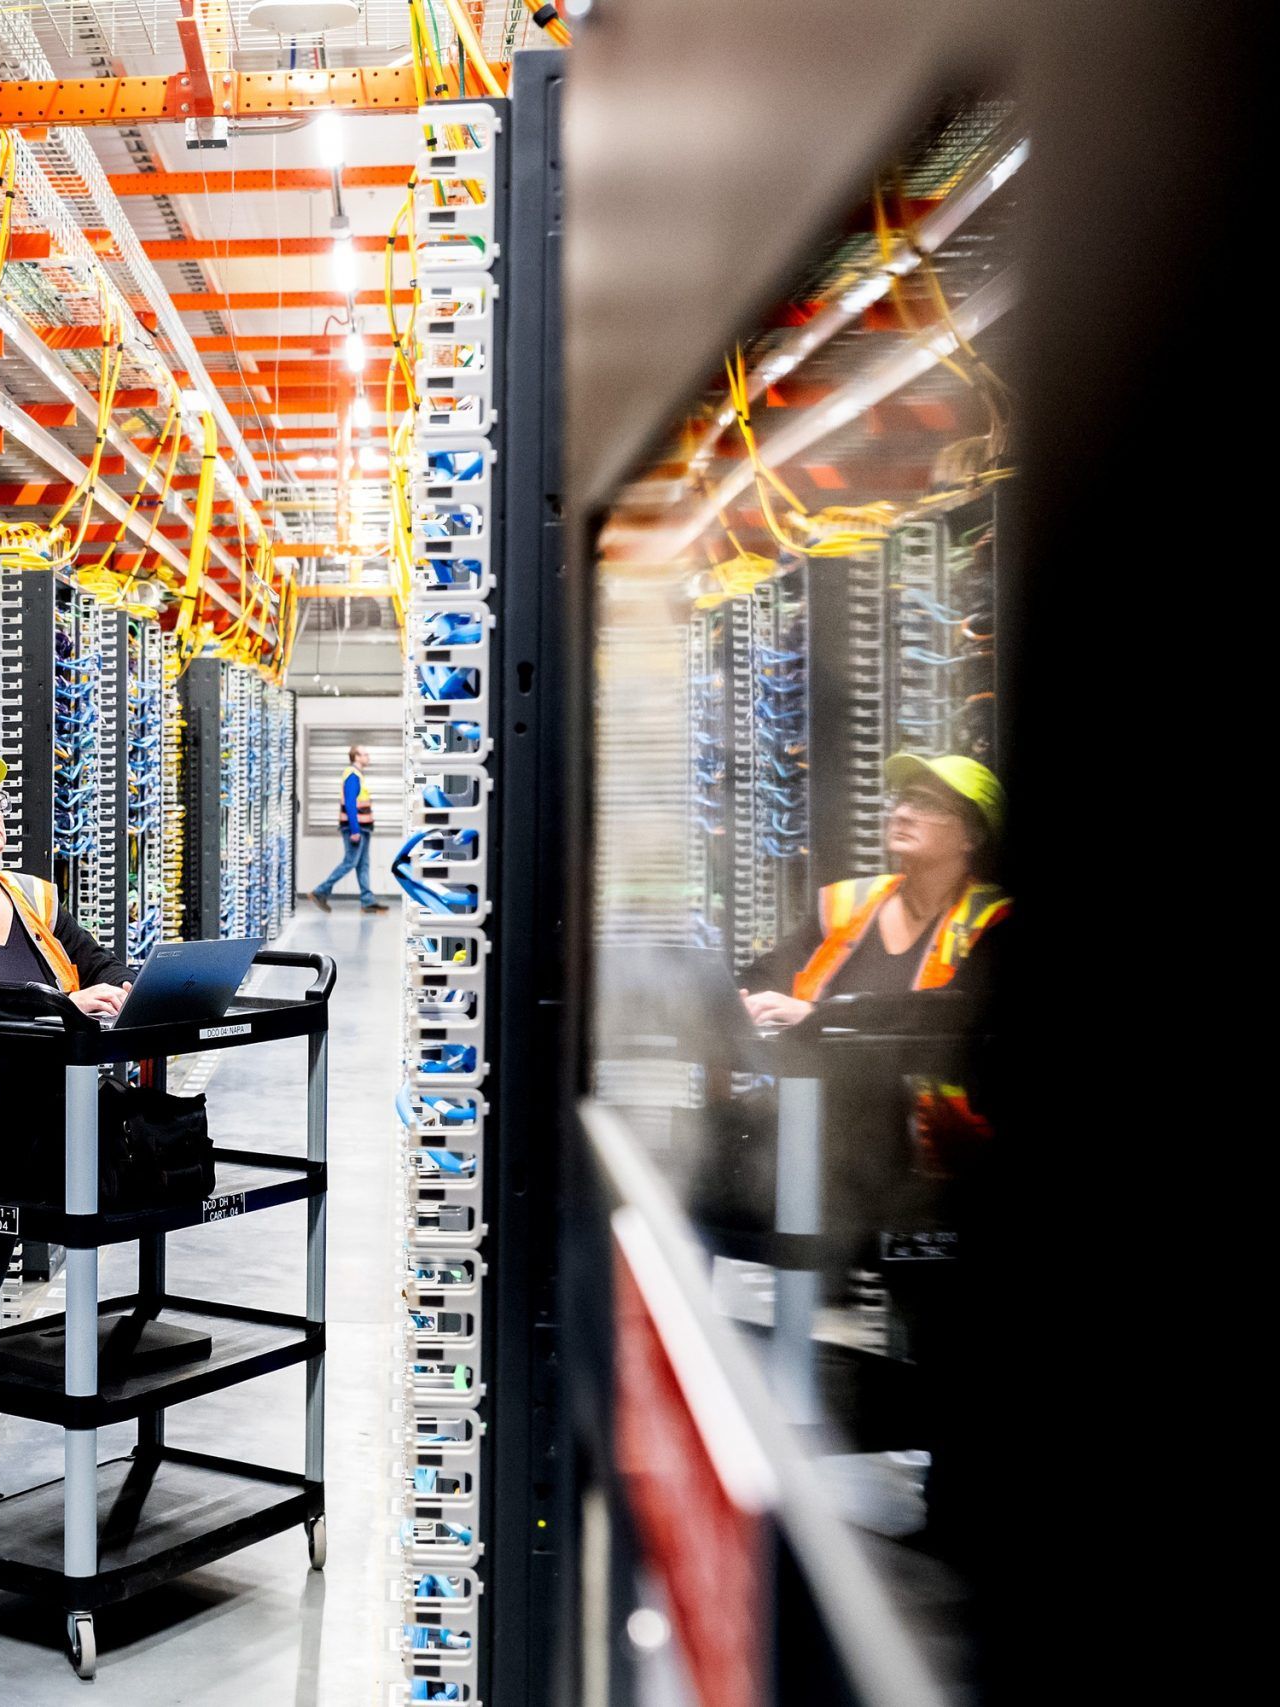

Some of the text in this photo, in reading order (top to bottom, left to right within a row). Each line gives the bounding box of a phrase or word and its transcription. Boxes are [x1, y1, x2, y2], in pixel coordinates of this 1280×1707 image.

[230, 1025, 245, 1034] NAPA
[202, 1200, 217, 1211] DCO
[220, 1197, 229, 1207] DH
[210, 1207, 239, 1221] CART 04
